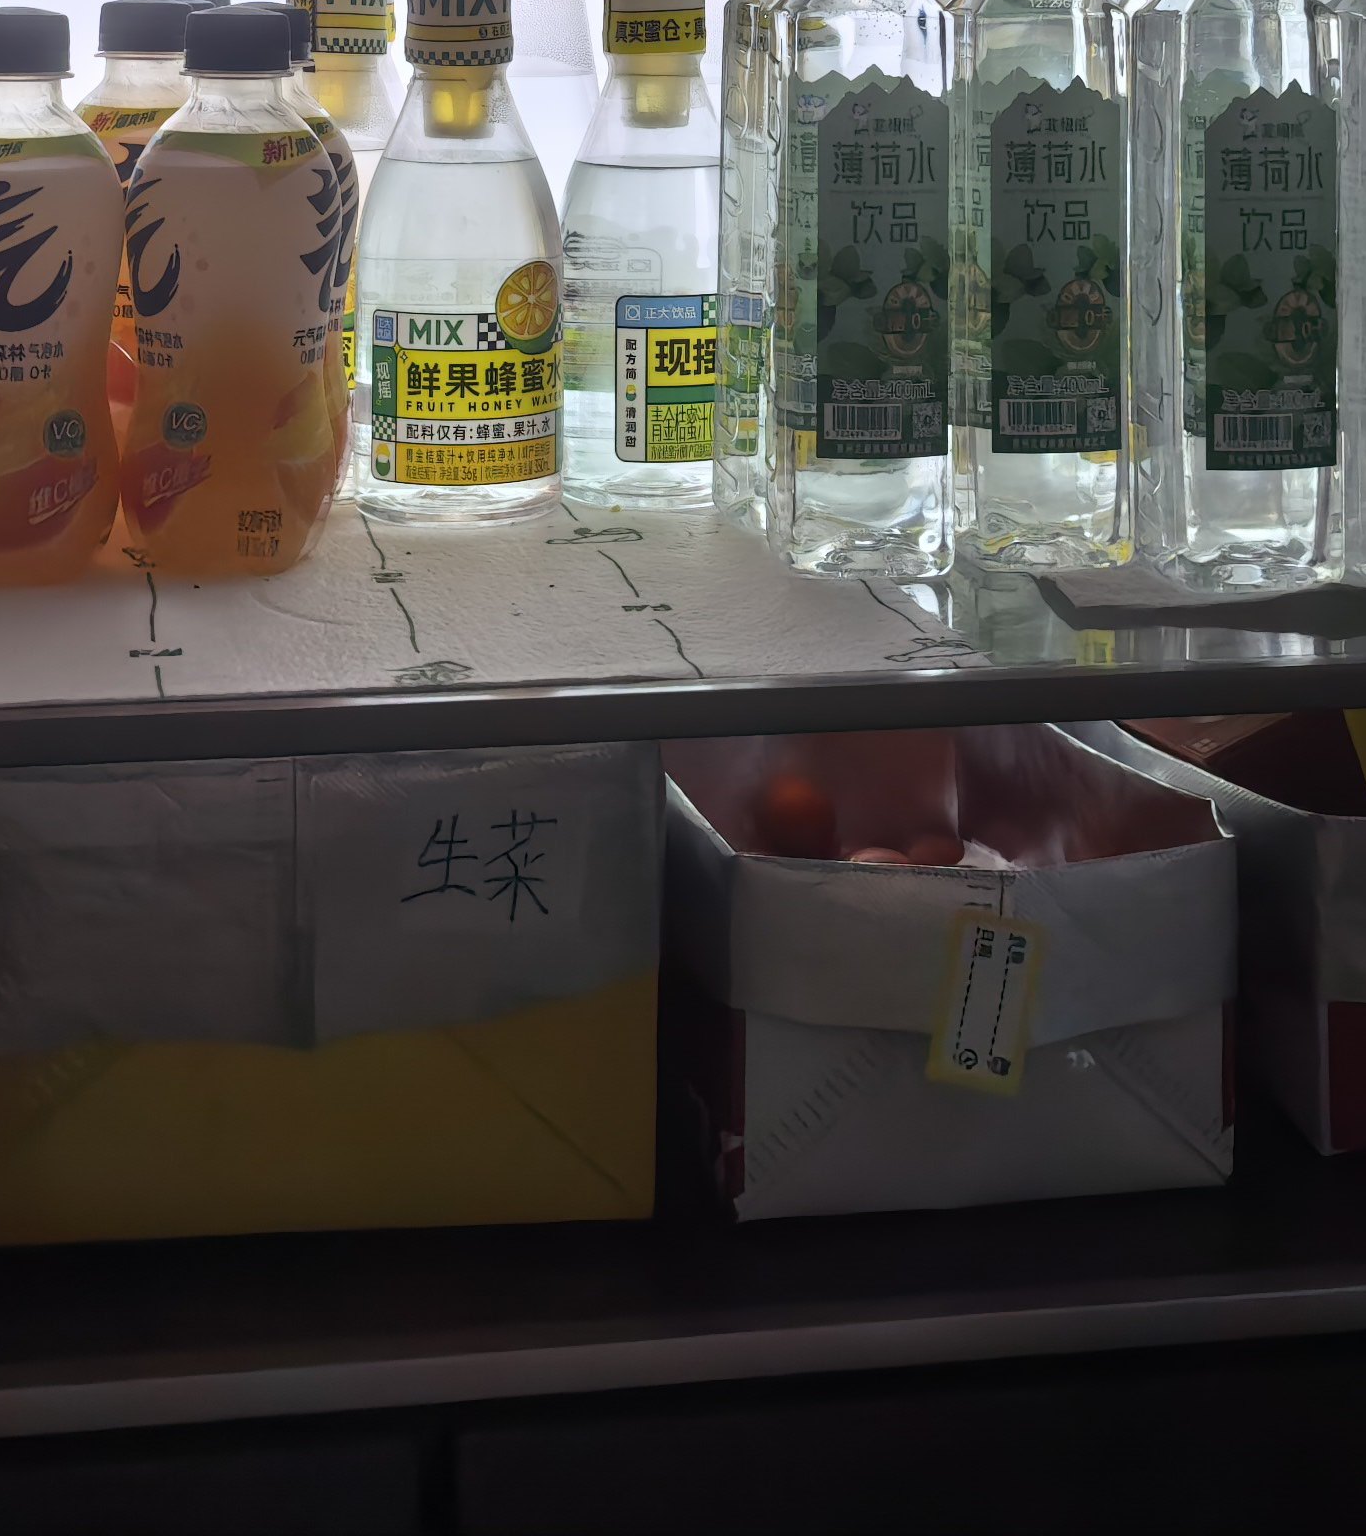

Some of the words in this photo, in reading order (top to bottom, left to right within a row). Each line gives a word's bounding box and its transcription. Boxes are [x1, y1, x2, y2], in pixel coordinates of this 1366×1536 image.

[614, 19, 681, 45] 真实蜜仓
[831, 140, 936, 186] 薄荷水
[1004, 140, 1106, 184] 薄荷水
[1220, 145, 1324, 192] 薄荷水
[851, 200, 920, 245] 饮品
[1023, 199, 1091, 243] 饮品
[1239, 207, 1308, 252] 饮品
[409, 318, 464, 346] MIX
[644, 305, 697, 320] 正大饮品
[406, 353, 561, 399] 鲜果蜂蜜水
[625, 338, 637, 380] 配方简
[406, 400, 456, 413] FRUIT
[468, 399, 523, 413] HONEY
[401, 809, 558, 923] 生菜
